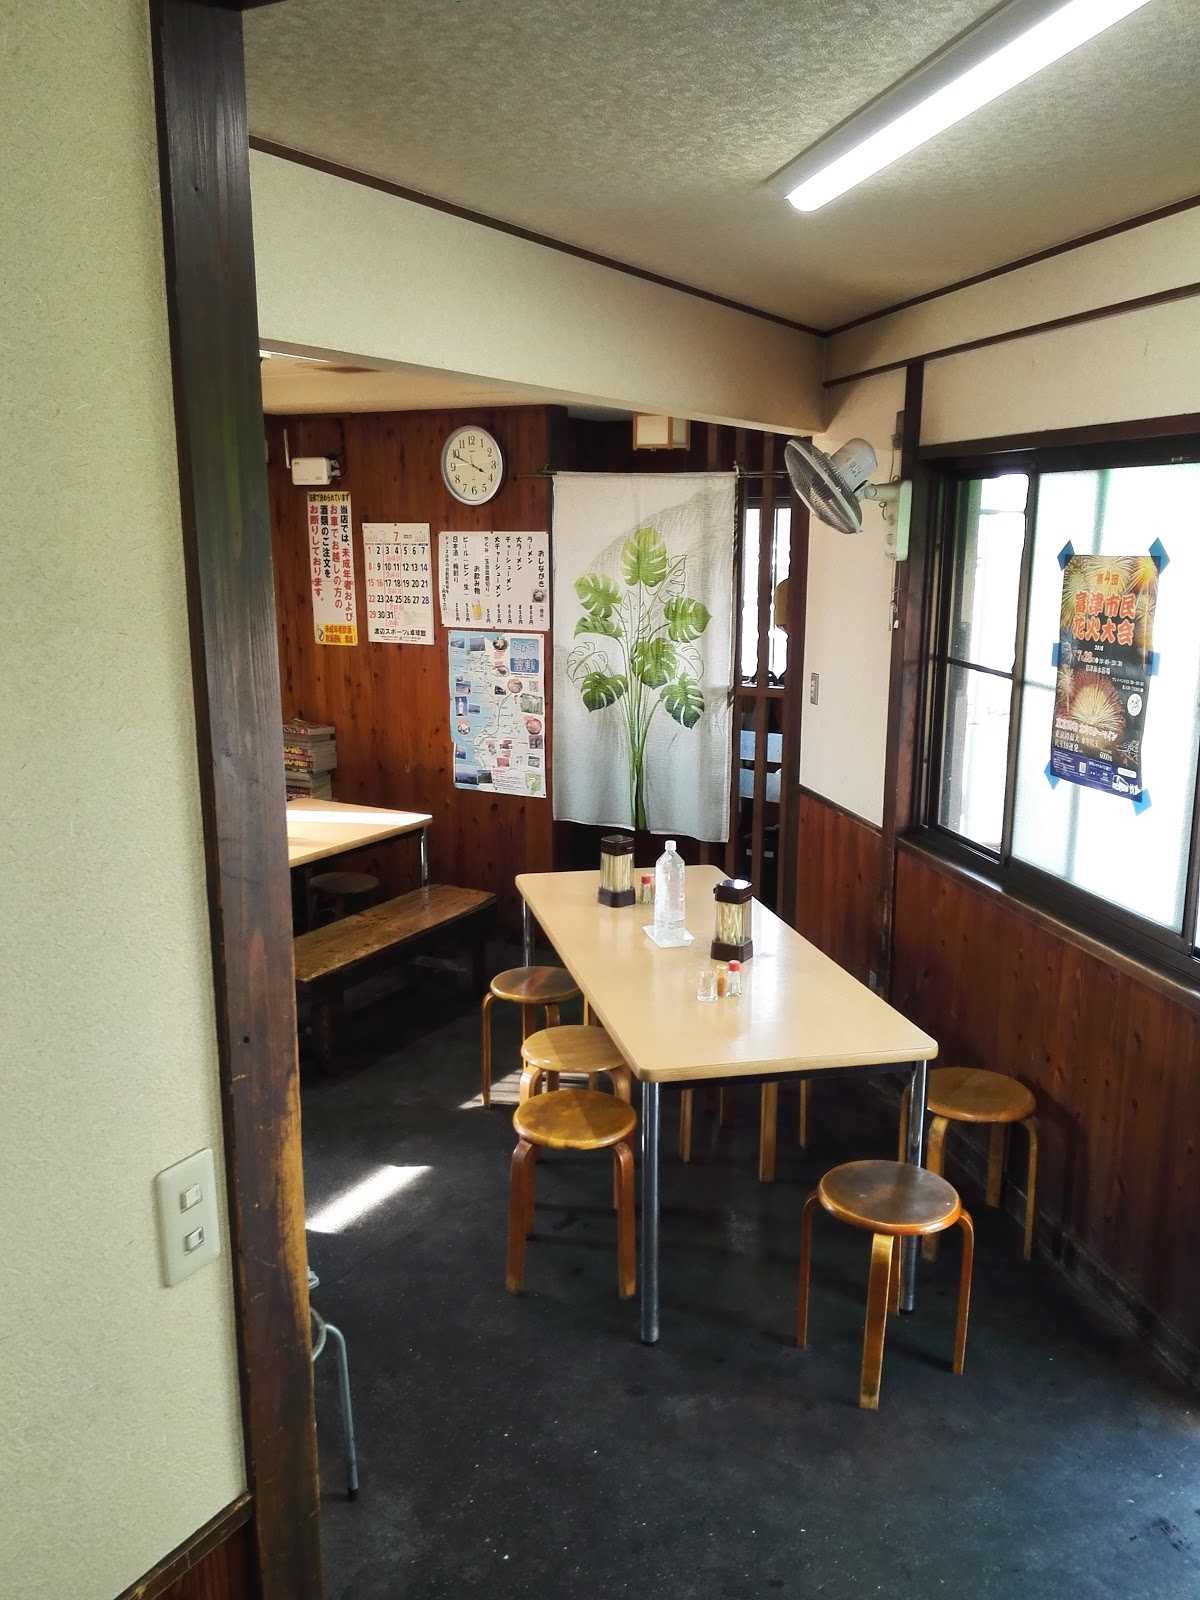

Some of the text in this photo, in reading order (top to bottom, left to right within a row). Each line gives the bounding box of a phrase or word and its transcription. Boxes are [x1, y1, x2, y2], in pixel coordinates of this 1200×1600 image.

[459, 439, 465, 449] 11
[468, 435, 476, 446] 12
[480, 439, 484, 448] 1
[453, 448, 460, 458] 10
[487, 447, 493, 457] 2
[450, 462, 456, 472] 9
[491, 460, 497, 469] 3
[455, 474, 461, 484] 8
[488, 473, 493, 483] 4
[463, 483, 468, 493] 7
[471, 486, 478, 495] 6
[482, 483, 487, 493] 5
[320, 505, 331, 578] 酒類のご注文を
[394, 532, 399, 541] 7
[368, 546, 371, 554] 1
[377, 546, 381, 554] 2
[386, 546, 390, 554] 3
[403, 547, 407, 555] 5
[412, 547, 416, 555] 6
[421, 547, 425, 555] 7
[330, 505, 343, 609] お車でお越しの方の
[377, 562, 381, 571] 9
[385, 563, 391, 571] 10
[394, 563, 400, 571] 11
[403, 563, 409, 571] 12
[411, 563, 418, 572] 13
[421, 564, 428, 572] 14
[385, 579, 391, 587] 17
[403, 580, 410, 588] 19
[411, 579, 420, 588] 20
[421, 580, 428, 588] 21
[368, 595, 430, 605] 22 23 24 25 26 27 28
[369, 611, 394, 619] 29 30 31
[1071, 615, 1135, 647] 花火大会
